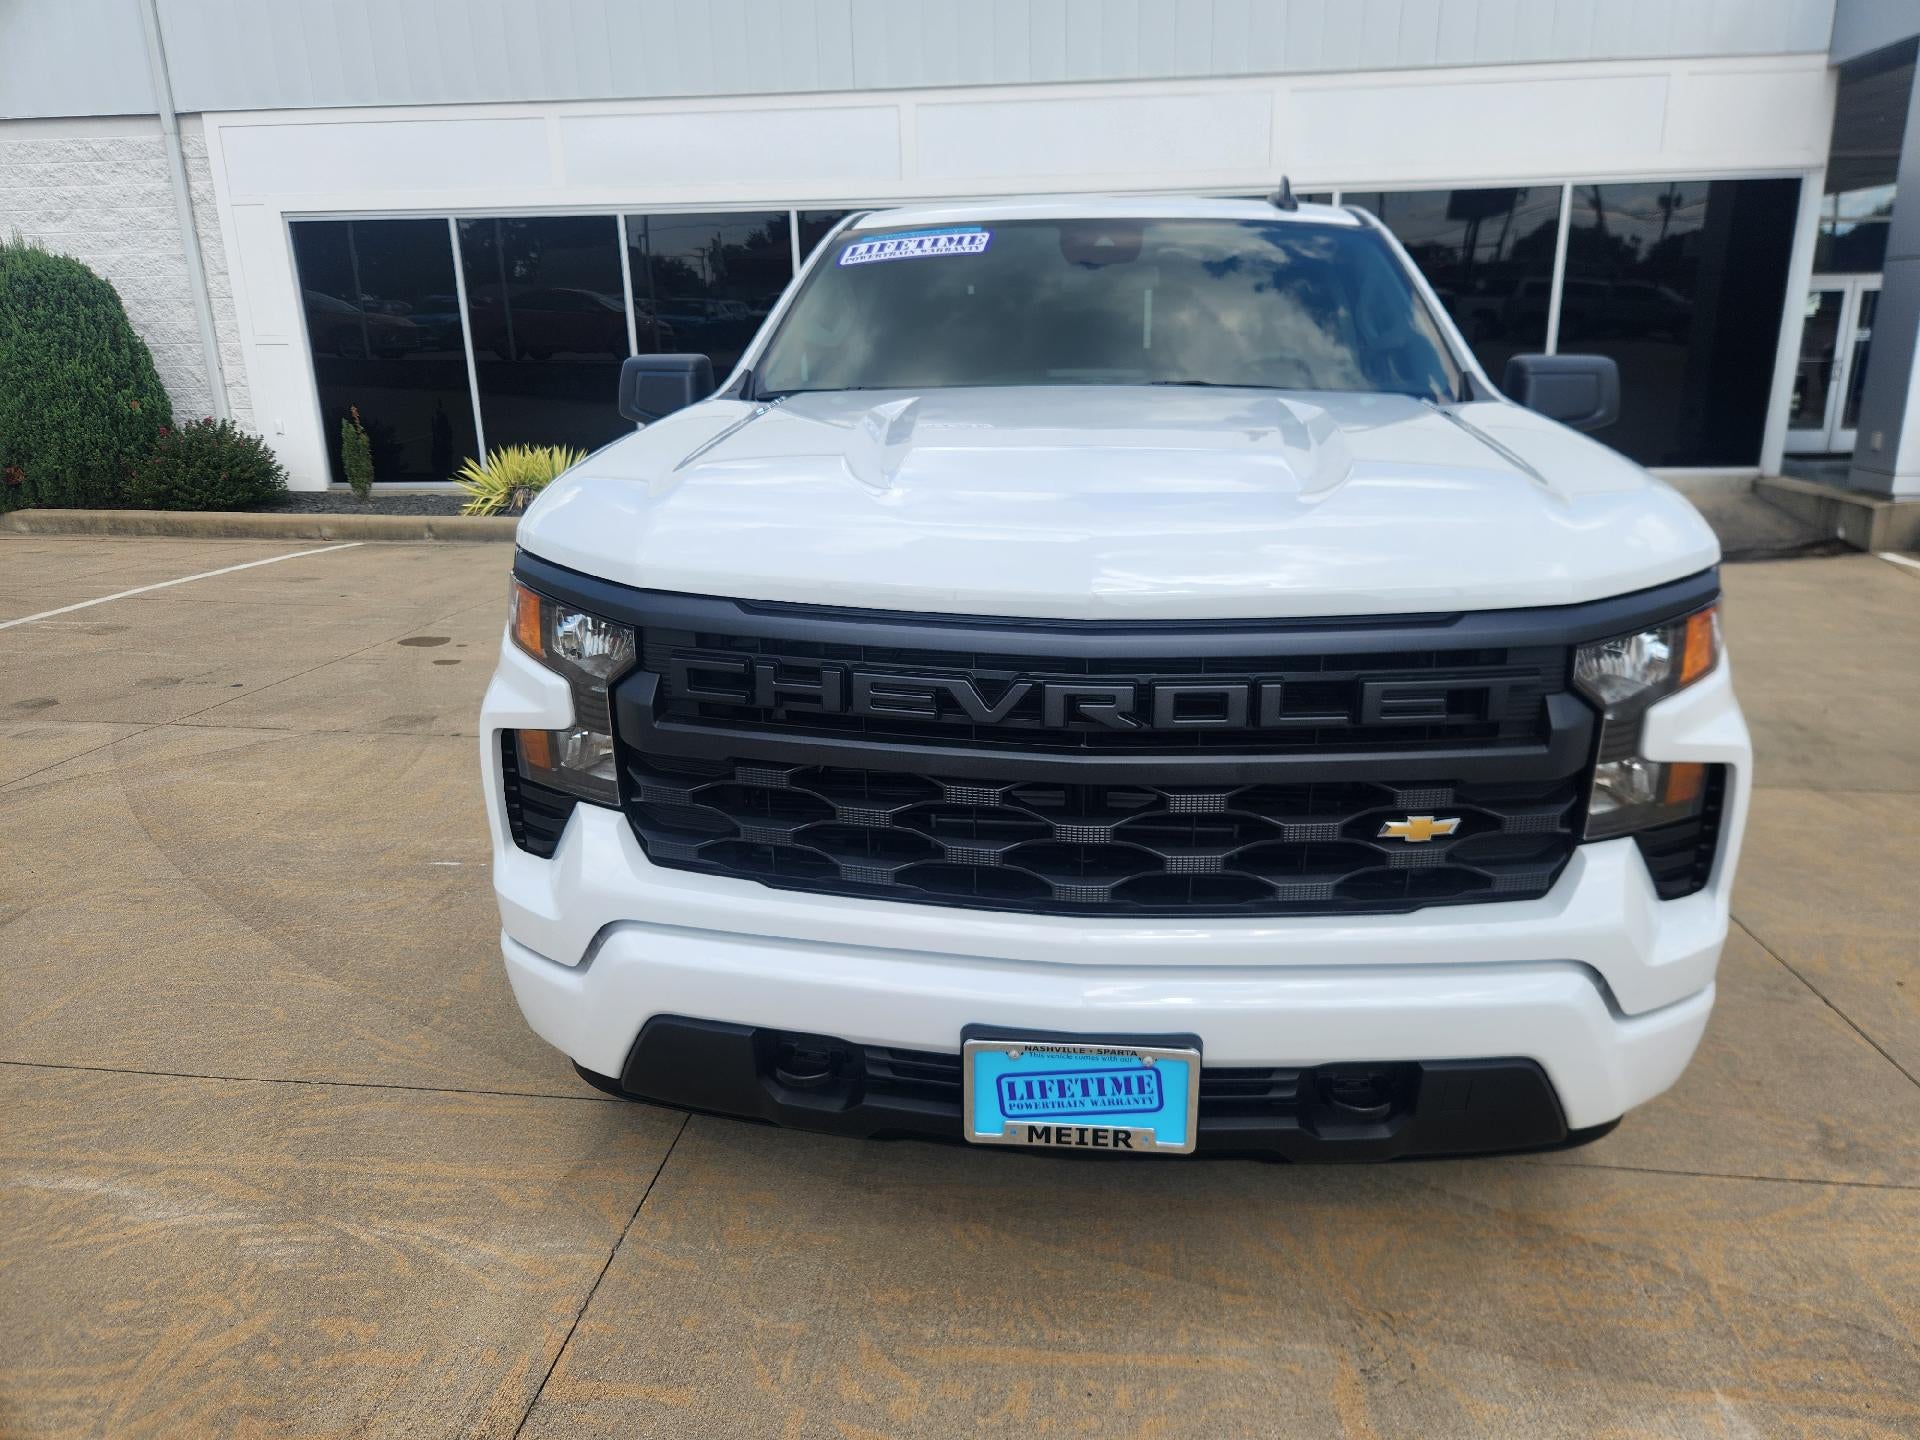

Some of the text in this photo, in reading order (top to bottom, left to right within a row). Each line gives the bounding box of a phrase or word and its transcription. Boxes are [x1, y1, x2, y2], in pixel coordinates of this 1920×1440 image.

[845, 245, 982, 263] POWERTRAIN WARRANTY
[848, 234, 987, 257] LIFETIME
[671, 655, 1540, 729] CHEVROLET
[1024, 1045, 1138, 1057] NASHVILLE SPARTA
[1029, 1051, 1045, 1059] This
[1007, 1074, 1155, 1101] LIFETIME
[1008, 1096, 1155, 1111] POWERTRAIN WARRANTY
[1027, 1125, 1134, 1149] MEIER
